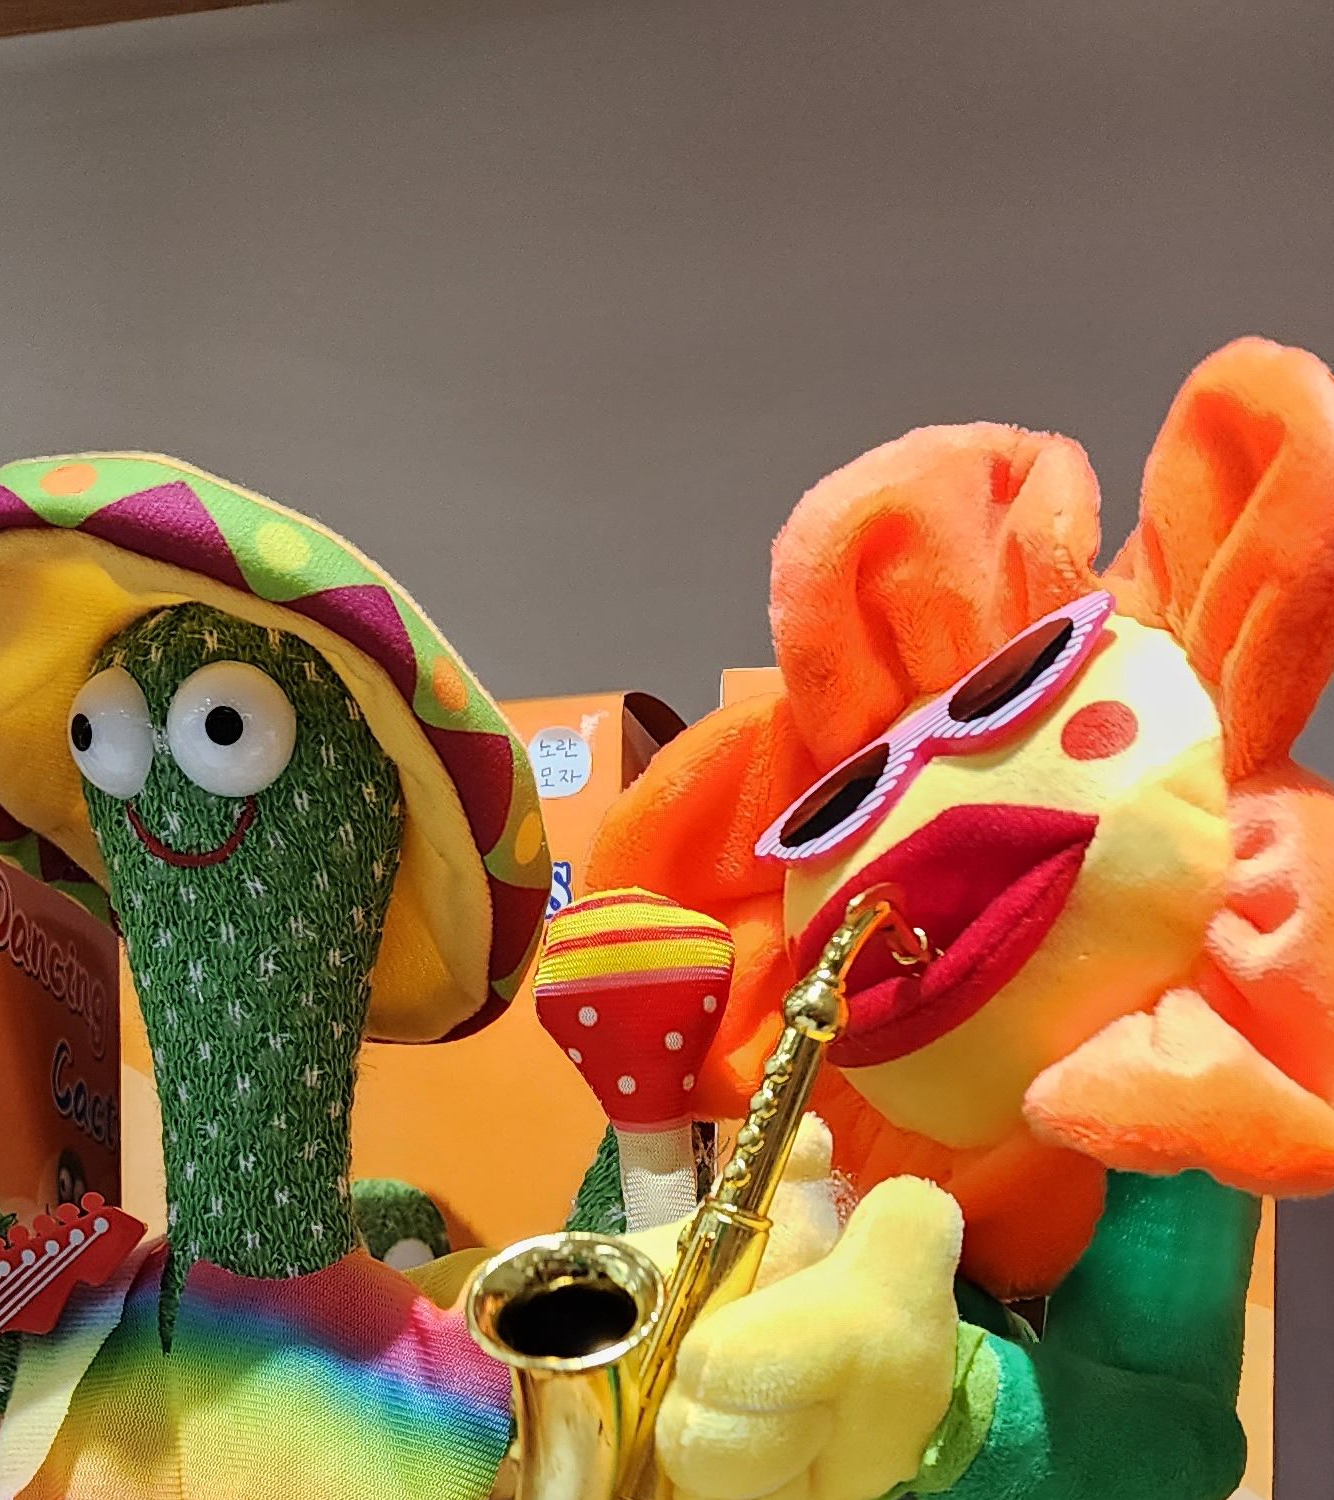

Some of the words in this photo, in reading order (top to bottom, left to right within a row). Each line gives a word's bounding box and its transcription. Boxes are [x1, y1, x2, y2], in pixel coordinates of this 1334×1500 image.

[539, 737, 579, 758] 노란
[540, 766, 582, 788] 모자
[51, 1038, 119, 1149] Cact
